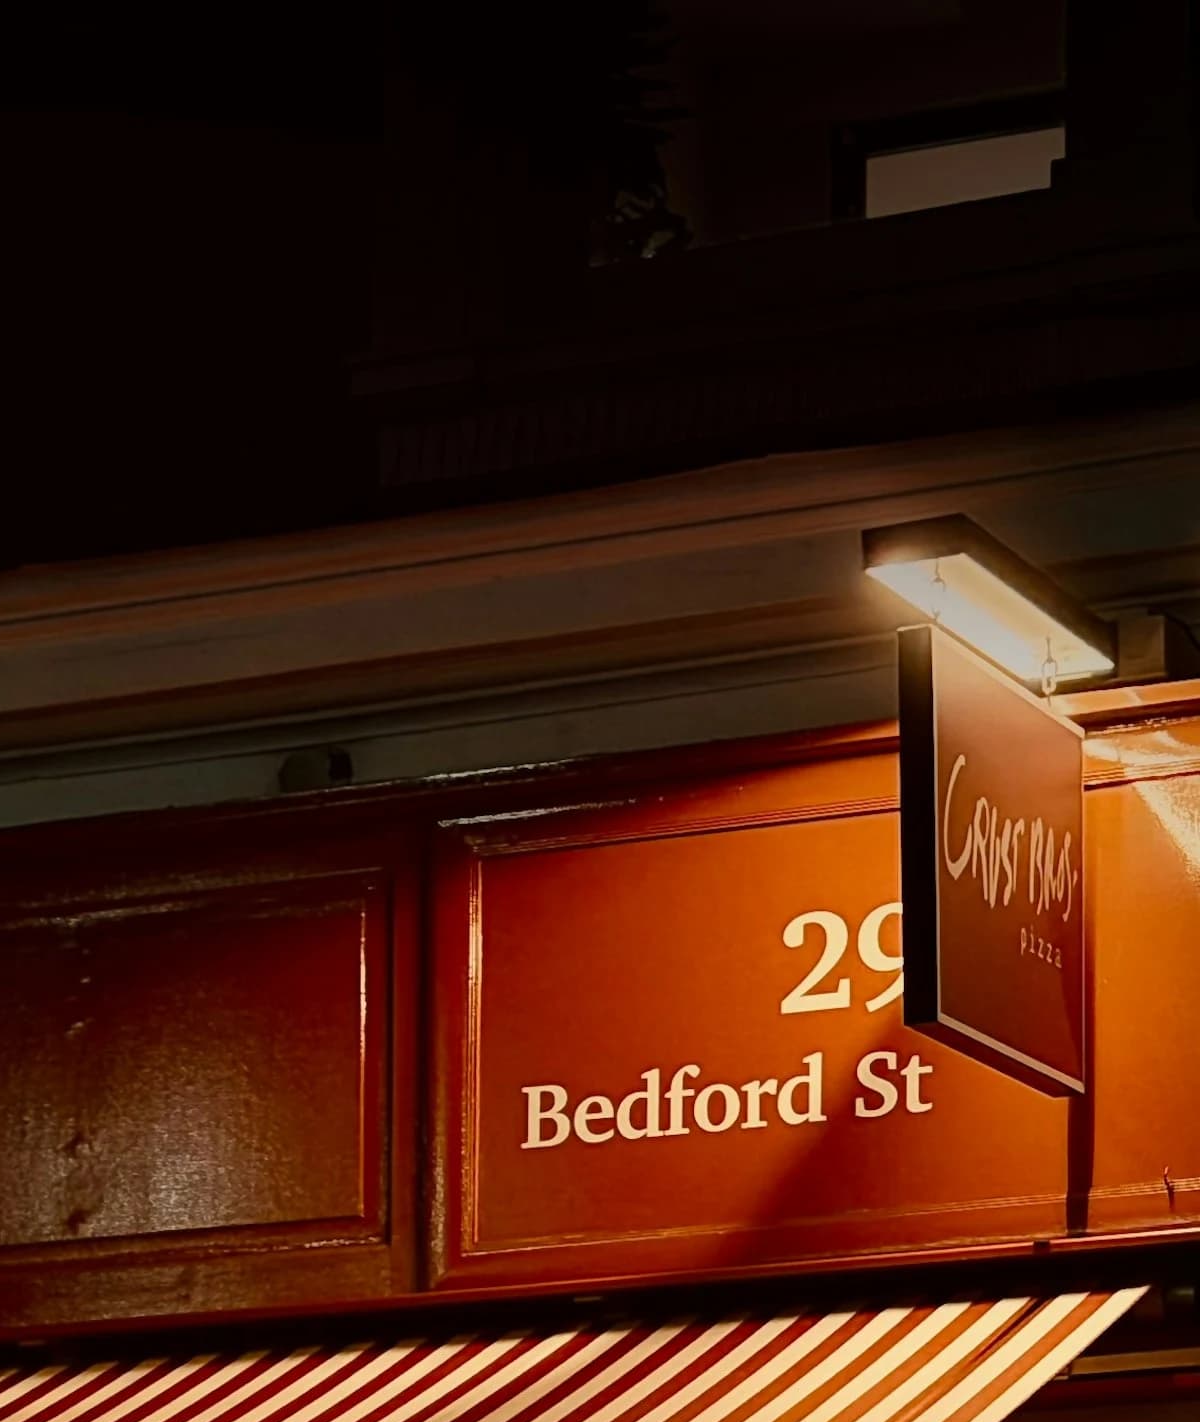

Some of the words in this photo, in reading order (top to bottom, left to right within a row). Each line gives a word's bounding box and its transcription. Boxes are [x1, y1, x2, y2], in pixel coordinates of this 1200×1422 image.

[780, 902, 904, 1014] 29
[1020, 925, 1063, 968] pizza
[520, 1052, 827, 1150] Bedford
[855, 1050, 933, 1119] St
